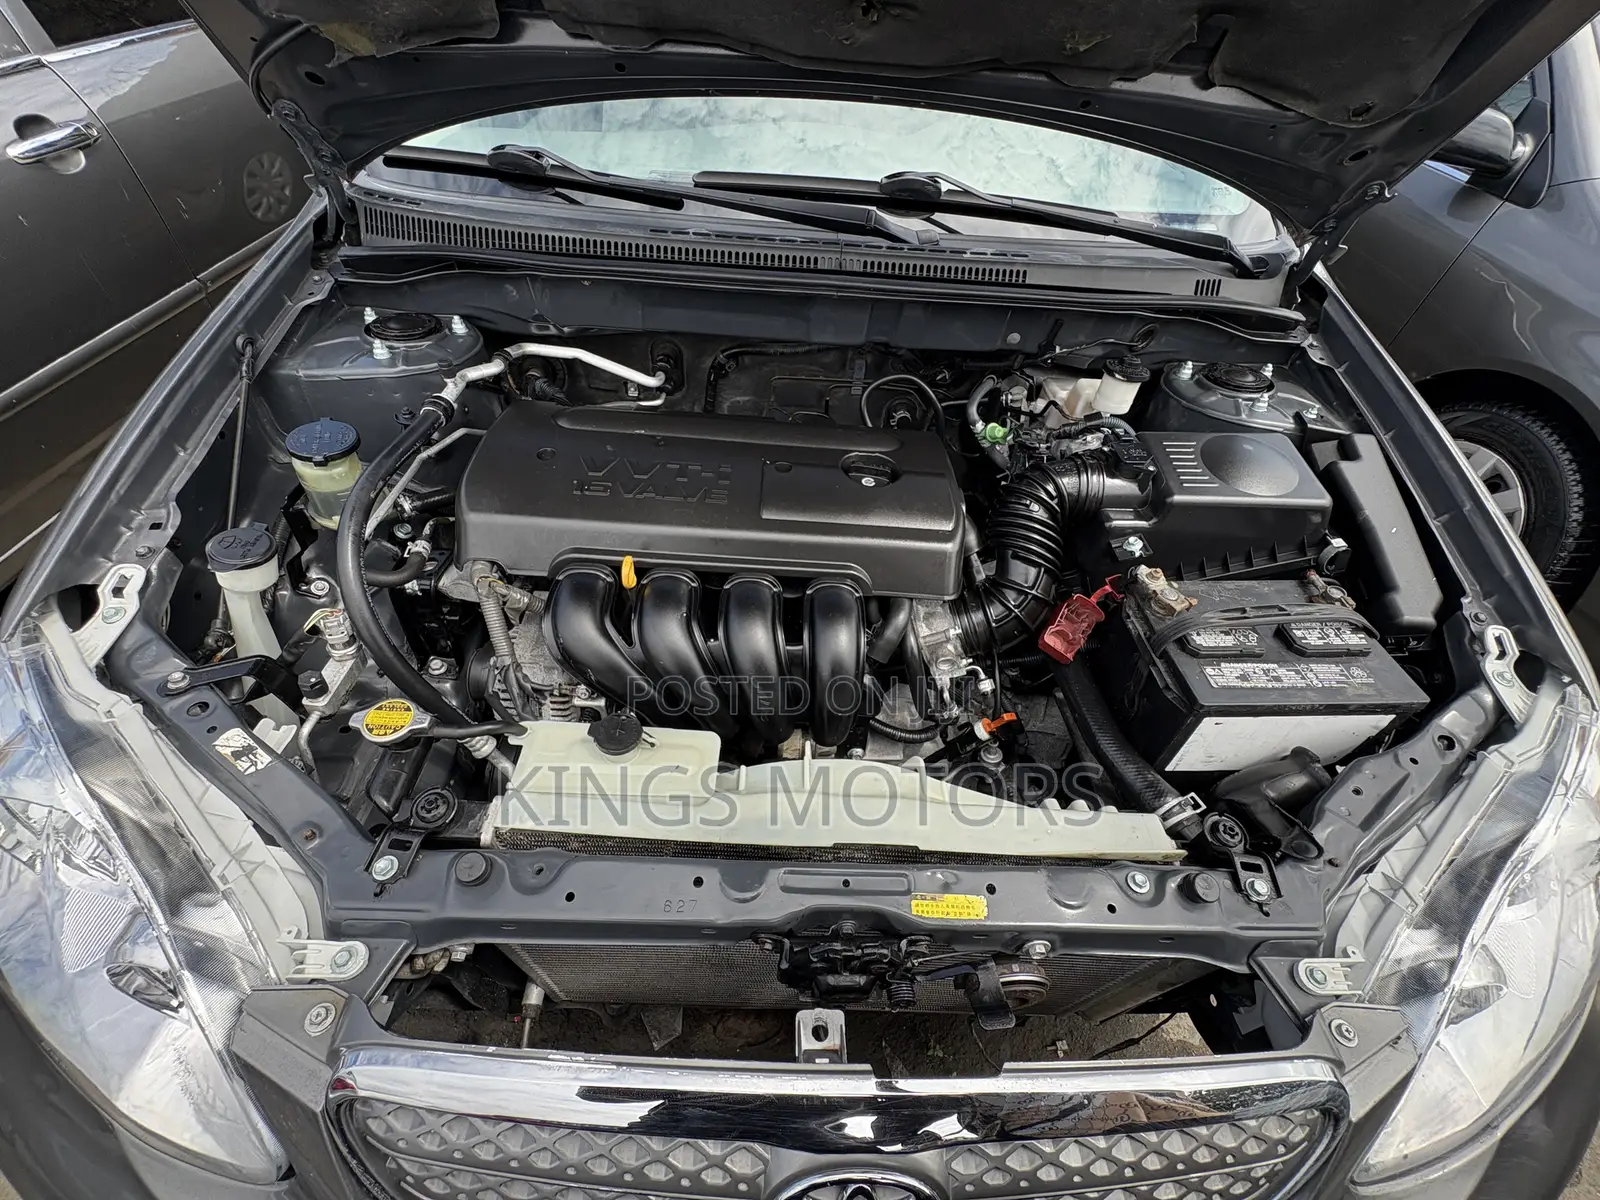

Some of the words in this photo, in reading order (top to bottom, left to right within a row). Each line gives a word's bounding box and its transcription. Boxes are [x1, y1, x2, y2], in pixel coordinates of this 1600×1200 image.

[572, 479, 612, 497] 16
[616, 481, 729, 504] VALVE
[663, 899, 698, 913] 627
